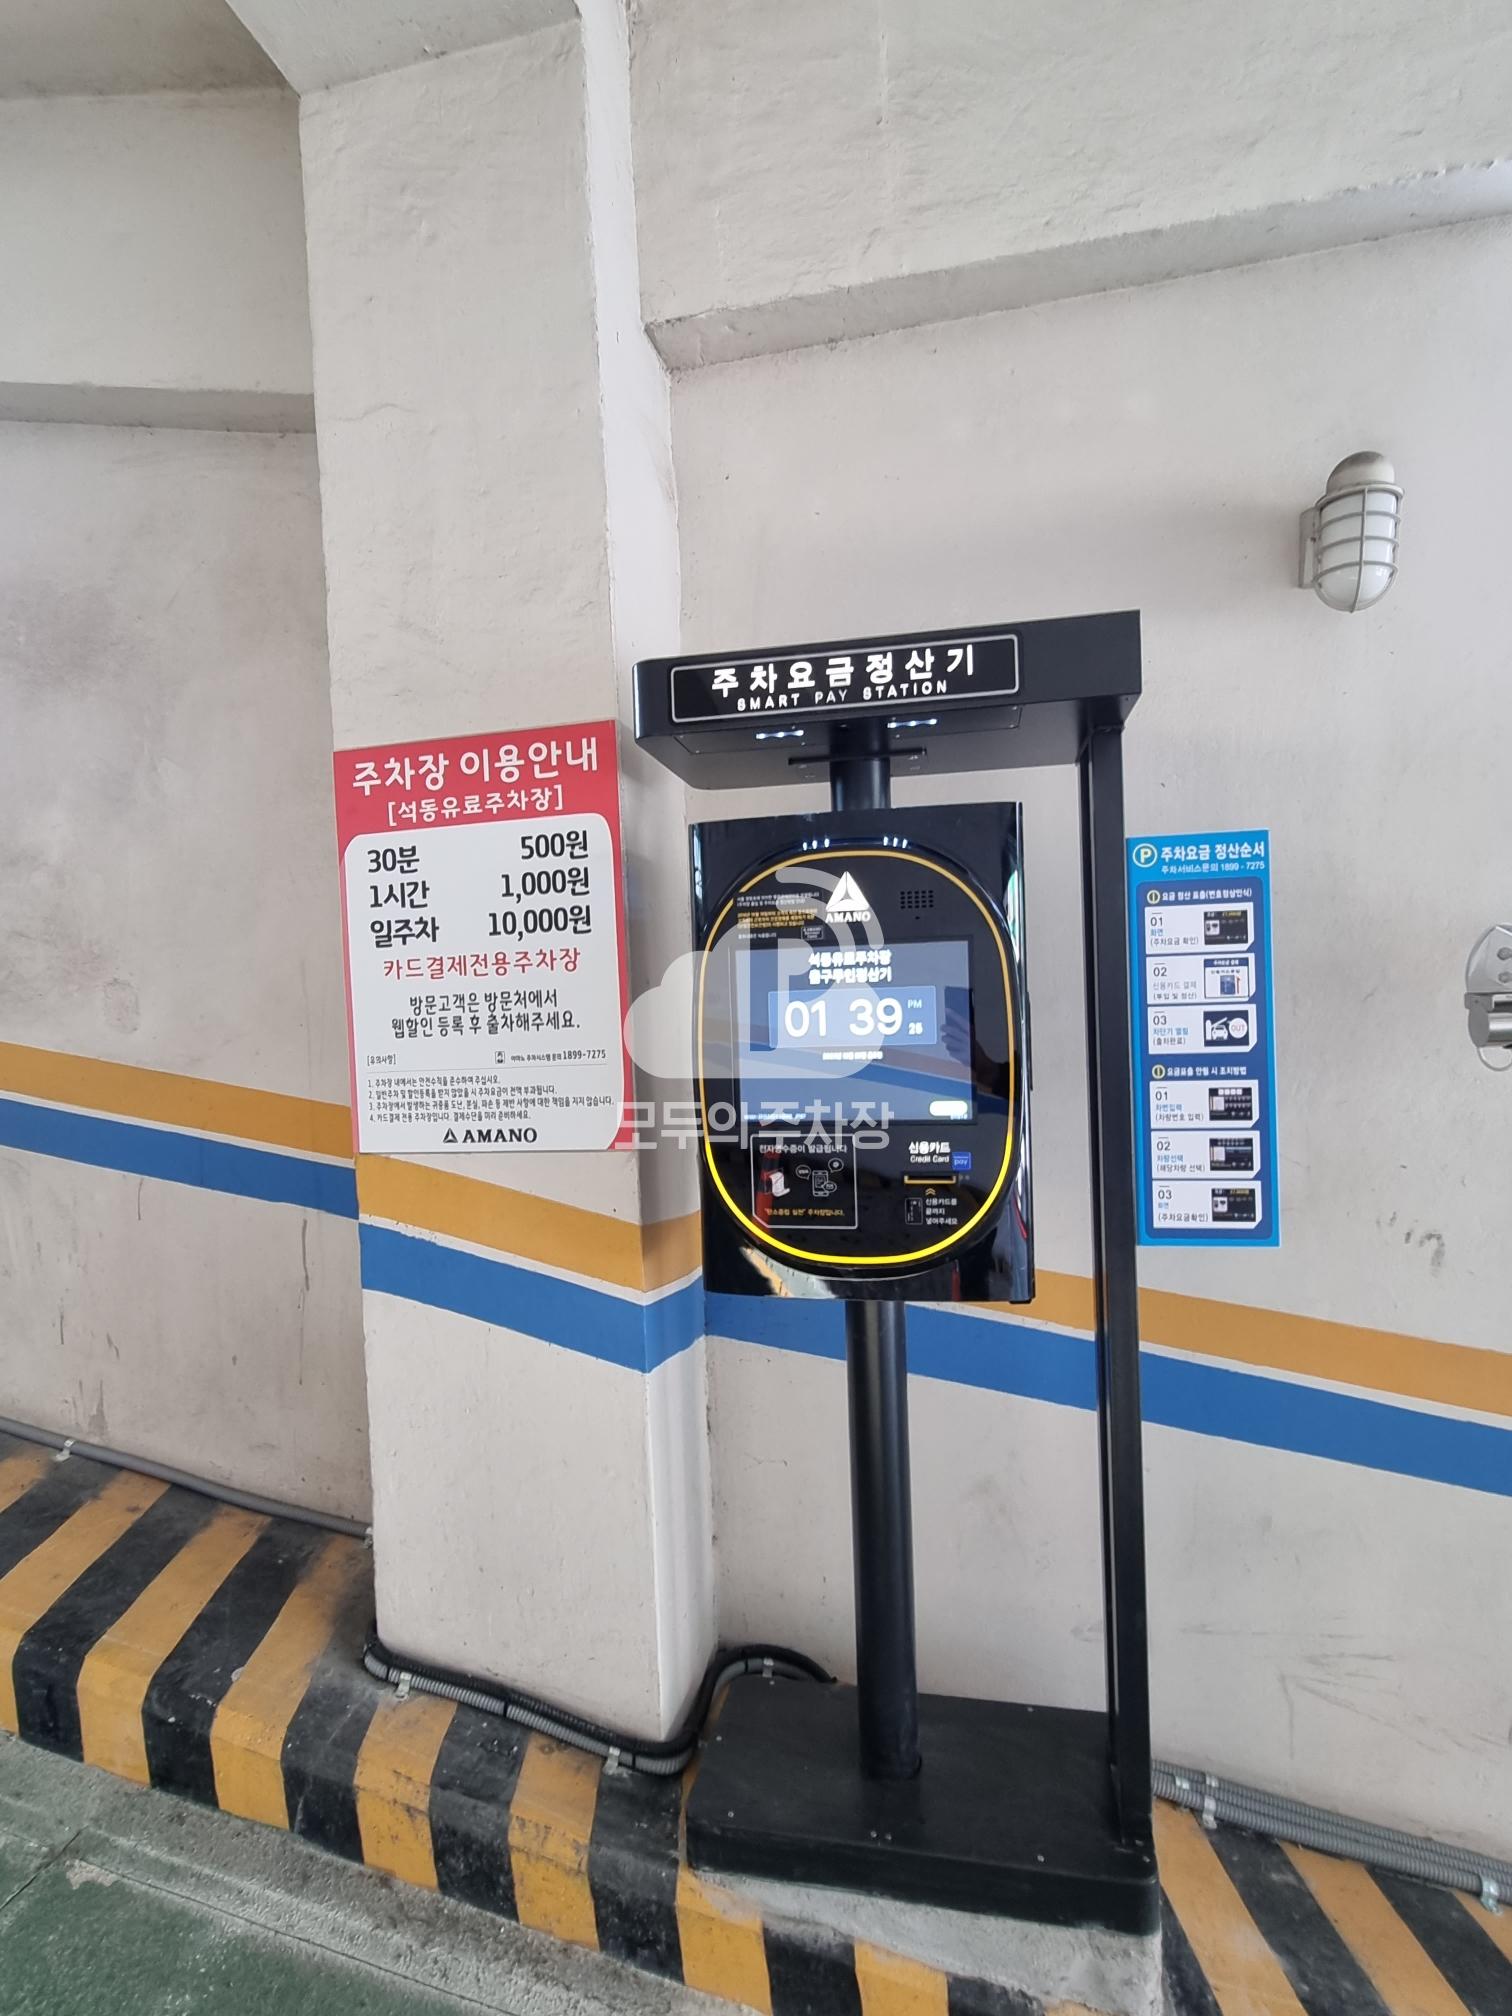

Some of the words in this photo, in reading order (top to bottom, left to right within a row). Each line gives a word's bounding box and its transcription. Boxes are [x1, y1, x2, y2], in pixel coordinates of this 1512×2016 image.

[711, 644, 974, 698] 주차요금정산기
[737, 693, 800, 711] SMART
[815, 690, 847, 704] PAY
[863, 679, 948, 701] STATION
[352, 753, 449, 796] 주차장
[460, 737, 598, 783] 이용안내
[387, 784, 563, 826] [석동유료주차장]
[367, 845, 420, 873] 30분
[520, 830, 589, 860] 500원
[1161, 844, 1210, 862] 주차요금
[1215, 841, 1264, 859] 정산순서
[1161, 863, 1219, 875] 주차서비스문의
[369, 880, 430, 908] 1시간
[500, 867, 590, 903] 1,000원
[826, 911, 871, 923] AMANO
[1150, 917, 1163, 927] 01
[370, 916, 439, 948] 일주차
[488, 905, 592, 942] 10,000원
[384, 947, 580, 980] 카드결제전용주차장
[1153, 967, 1167, 977] 02
[409, 992, 479, 1016] 방문고객은
[484, 989, 558, 1012] 방문처에서
[391, 1016, 433, 1038] 웹할인
[437, 1016, 464, 1036] 등록
[468, 1016, 482, 1035] 후
[486, 1010, 580, 1035] 출차해주세요.
[784, 1000, 827, 1037] 01
[849, 997, 903, 1036] 39
[907, 999, 922, 1009] PM
[1153, 1015, 1167, 1026] 03
[563, 1049, 606, 1060] 1899-7275
[1155, 1091, 1168, 1101] 01
[462, 1128, 538, 1144] AMANO
[908, 1141, 951, 1155] 신용카드
[1156, 1141, 1171, 1151] 02
[910, 1155, 931, 1164] Credit
[932, 1154, 950, 1163] Card
[1158, 1189, 1172, 1200] 03
